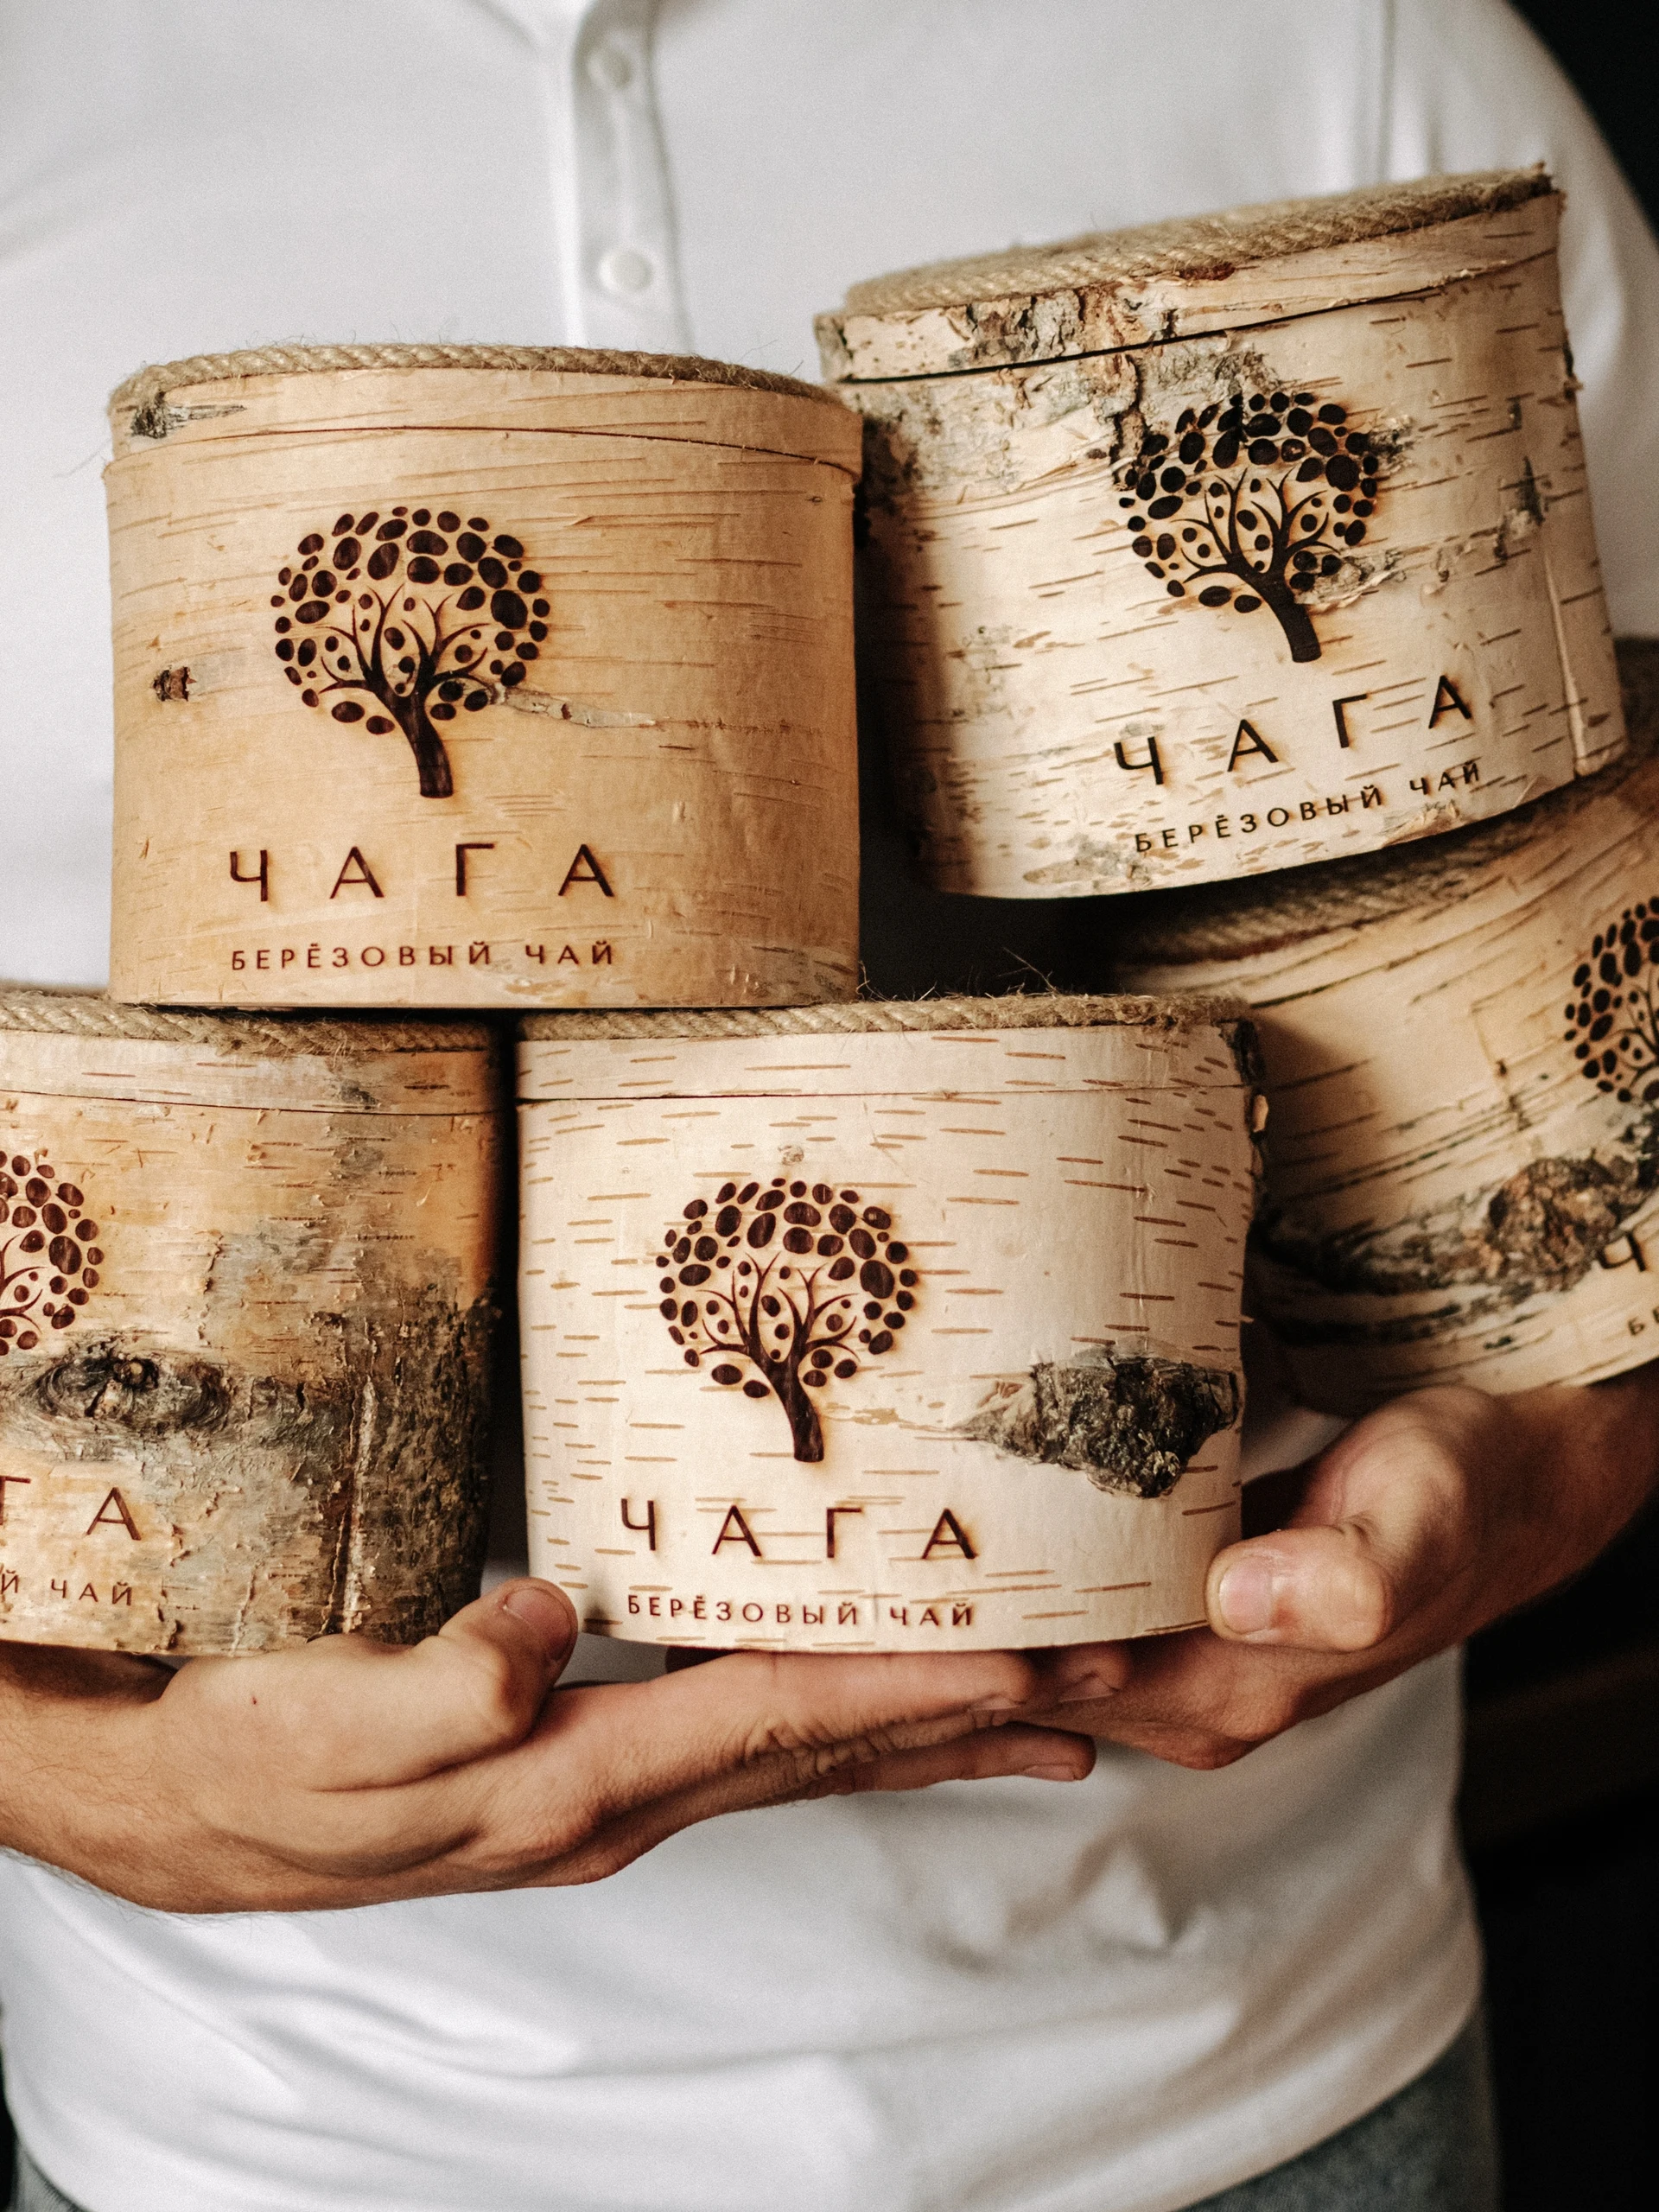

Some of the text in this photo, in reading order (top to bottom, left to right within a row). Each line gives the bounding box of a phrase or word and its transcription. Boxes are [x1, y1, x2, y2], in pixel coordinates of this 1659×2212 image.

[1113, 673, 1474, 785] ЧАГА
[1134, 760, 1480, 853] БЕРЁЗОВЫЙ ЧАЙ
[228, 842, 614, 902] ЧАГА
[231, 939, 613, 971] БЕРЁЗОВЫЙ ЧАЙ
[620, 1497, 980, 1560] ЧАГА
[50, 1578, 133, 1606] ЧАЙ
[626, 1594, 974, 1627] БЕРЁЗОВЫЙ ЧАЙ
